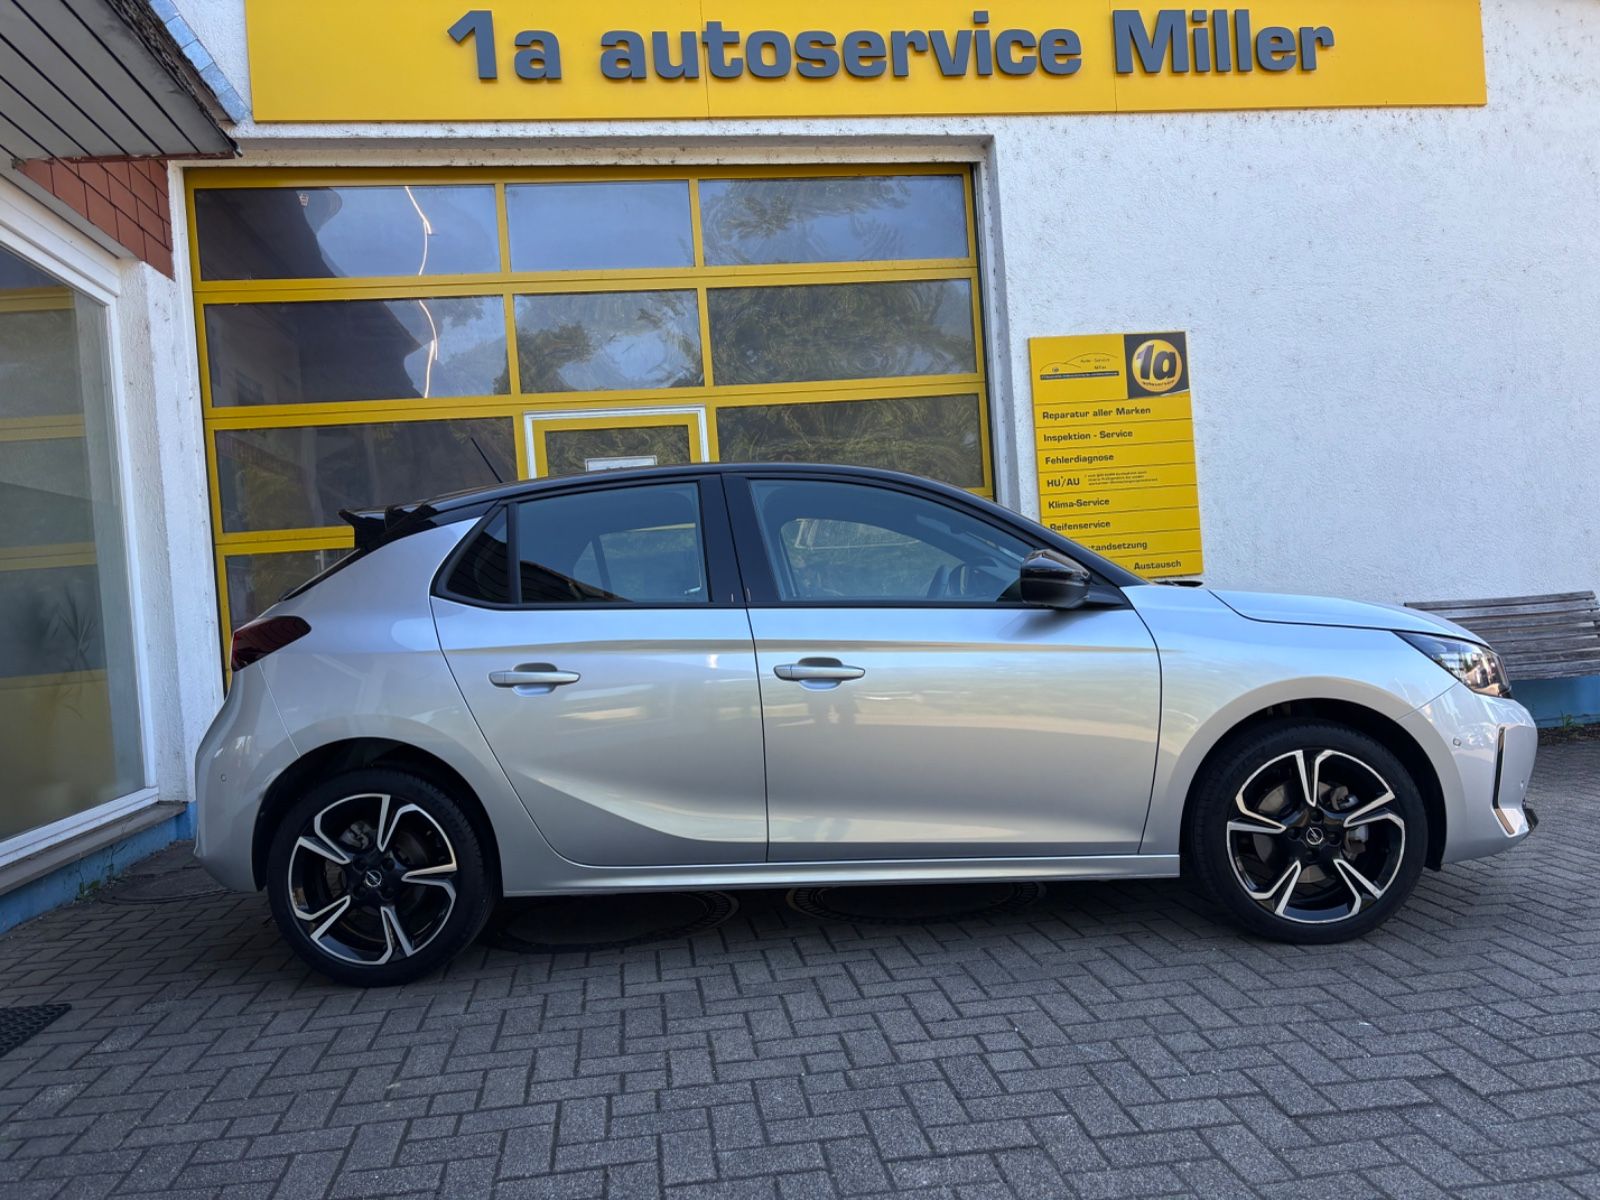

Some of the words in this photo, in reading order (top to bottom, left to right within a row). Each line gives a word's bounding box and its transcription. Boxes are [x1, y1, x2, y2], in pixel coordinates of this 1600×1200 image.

[447, 11, 562, 80] 1a
[600, 11, 1081, 79] autoservice
[1113, 9, 1335, 74] Miller
[1136, 344, 1176, 380] 1a
[1042, 410, 1089, 421] Reparatur
[1092, 408, 1113, 417] aller
[1116, 406, 1151, 416] Marken
[1043, 432, 1091, 443] Inspektion
[1099, 430, 1133, 439] Service
[1045, 453, 1114, 465] Fehlerdiagnose
[1048, 497, 1110, 509] Klima-Service
[1050, 520, 1111, 532] Reifenservice
[1088, 540, 1147, 551] tandsetzung
[1134, 559, 1181, 570] Austausch
